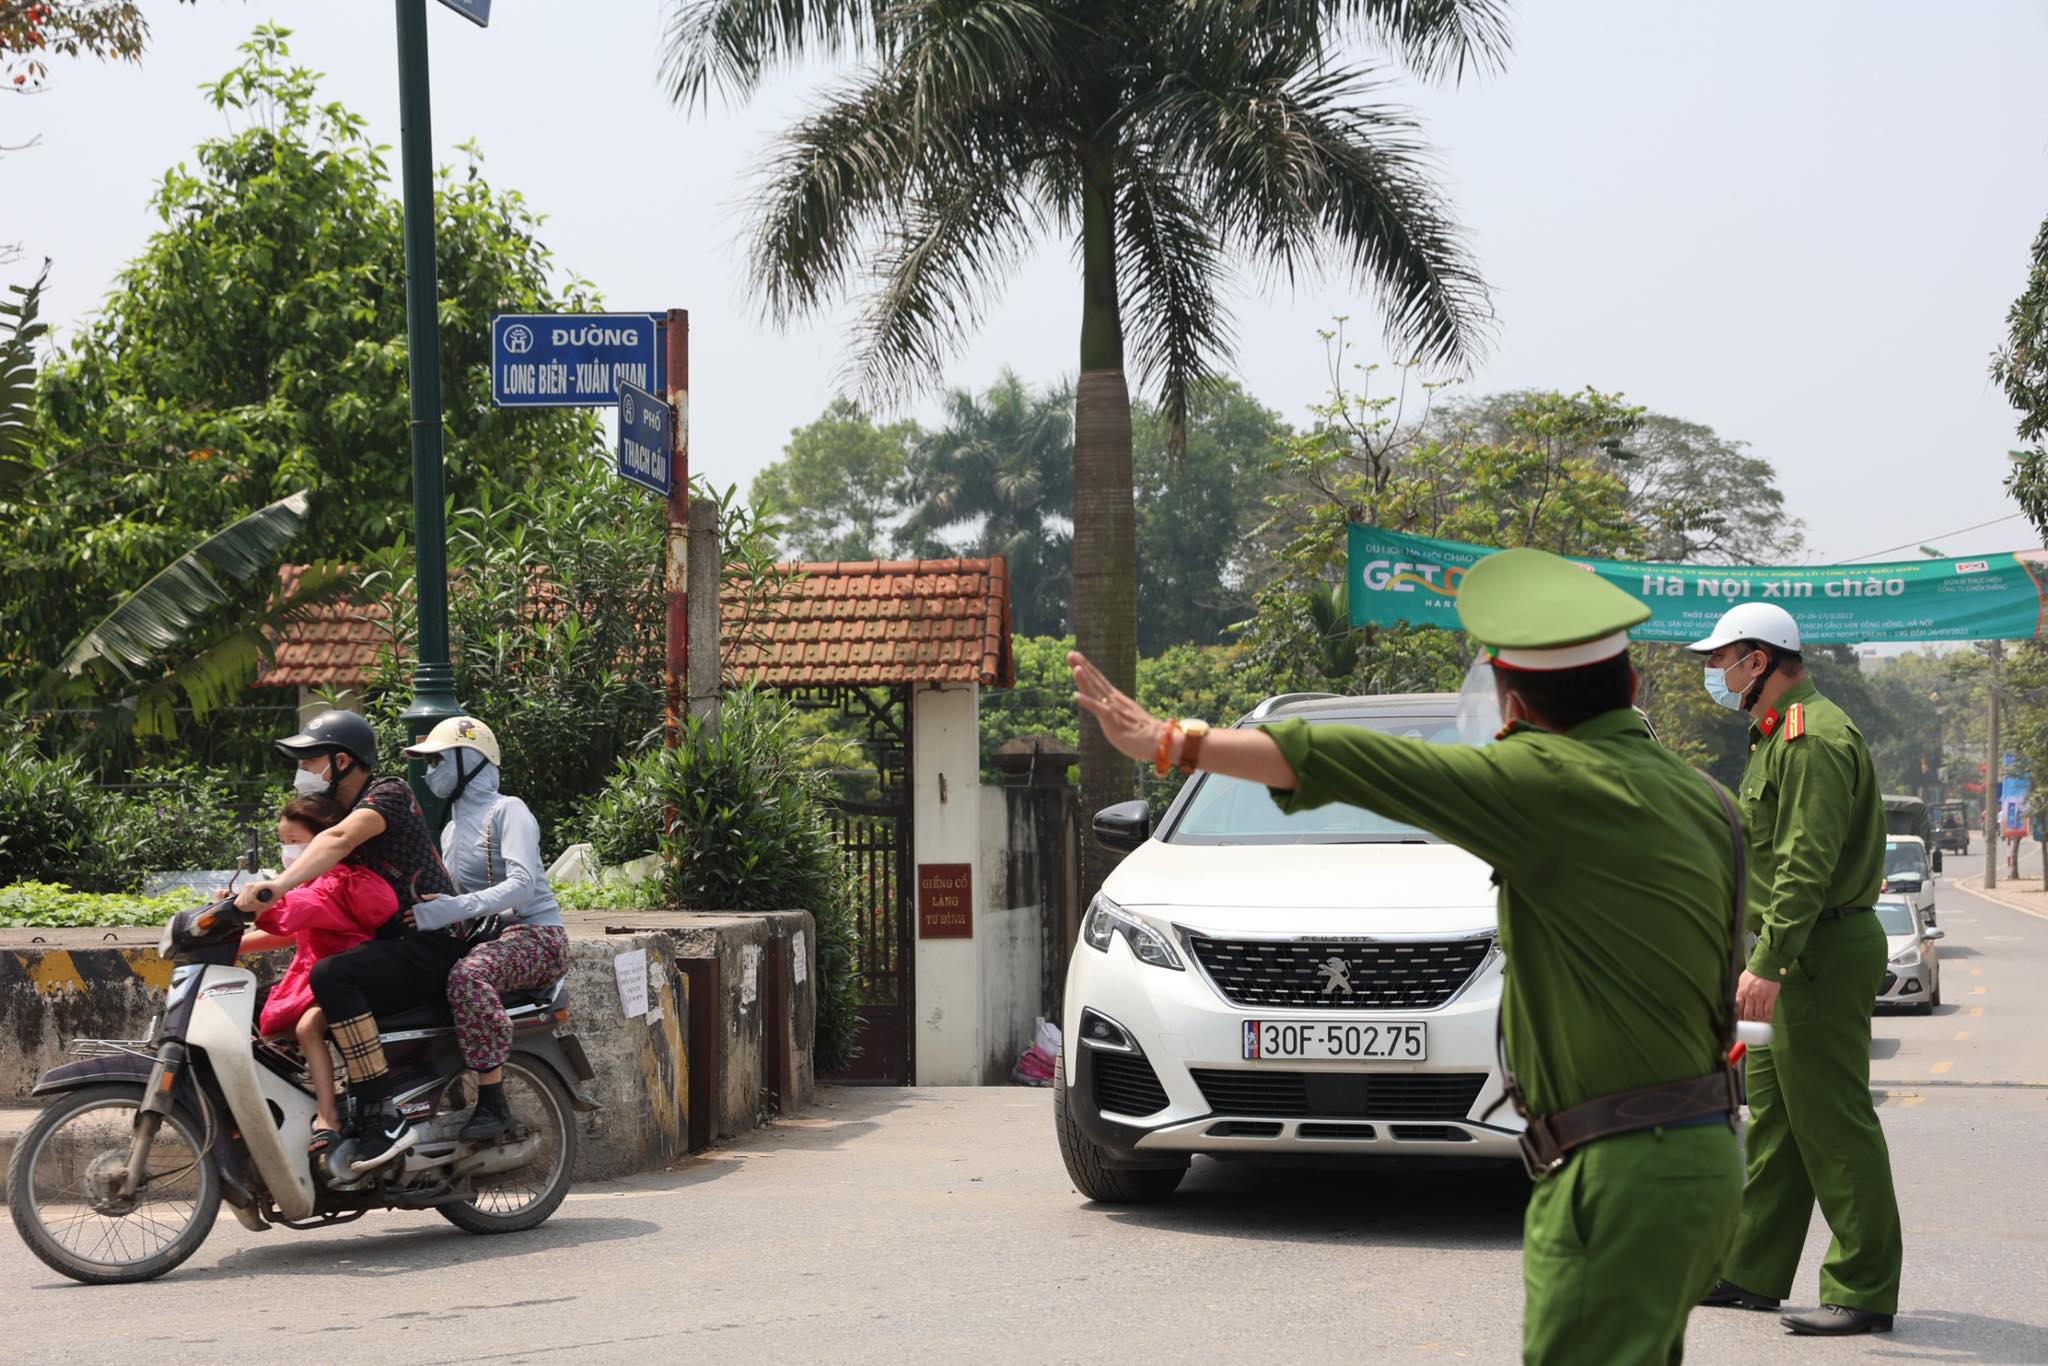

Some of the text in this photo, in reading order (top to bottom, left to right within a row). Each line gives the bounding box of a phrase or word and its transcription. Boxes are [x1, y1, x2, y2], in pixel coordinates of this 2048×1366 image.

[552, 324, 639, 346] ĐƯỜNG
[503, 364, 535, 395] LONG
[643, 408, 661, 432] PHỐ
[624, 437, 650, 475] THẠCH
[1642, 574, 1906, 603] Hà Nội xin chào
[932, 893, 959, 907] LÀNG
[1301, 935, 1370, 943] PEUGEOT
[1264, 1025, 1421, 1057] 30F-502.75
